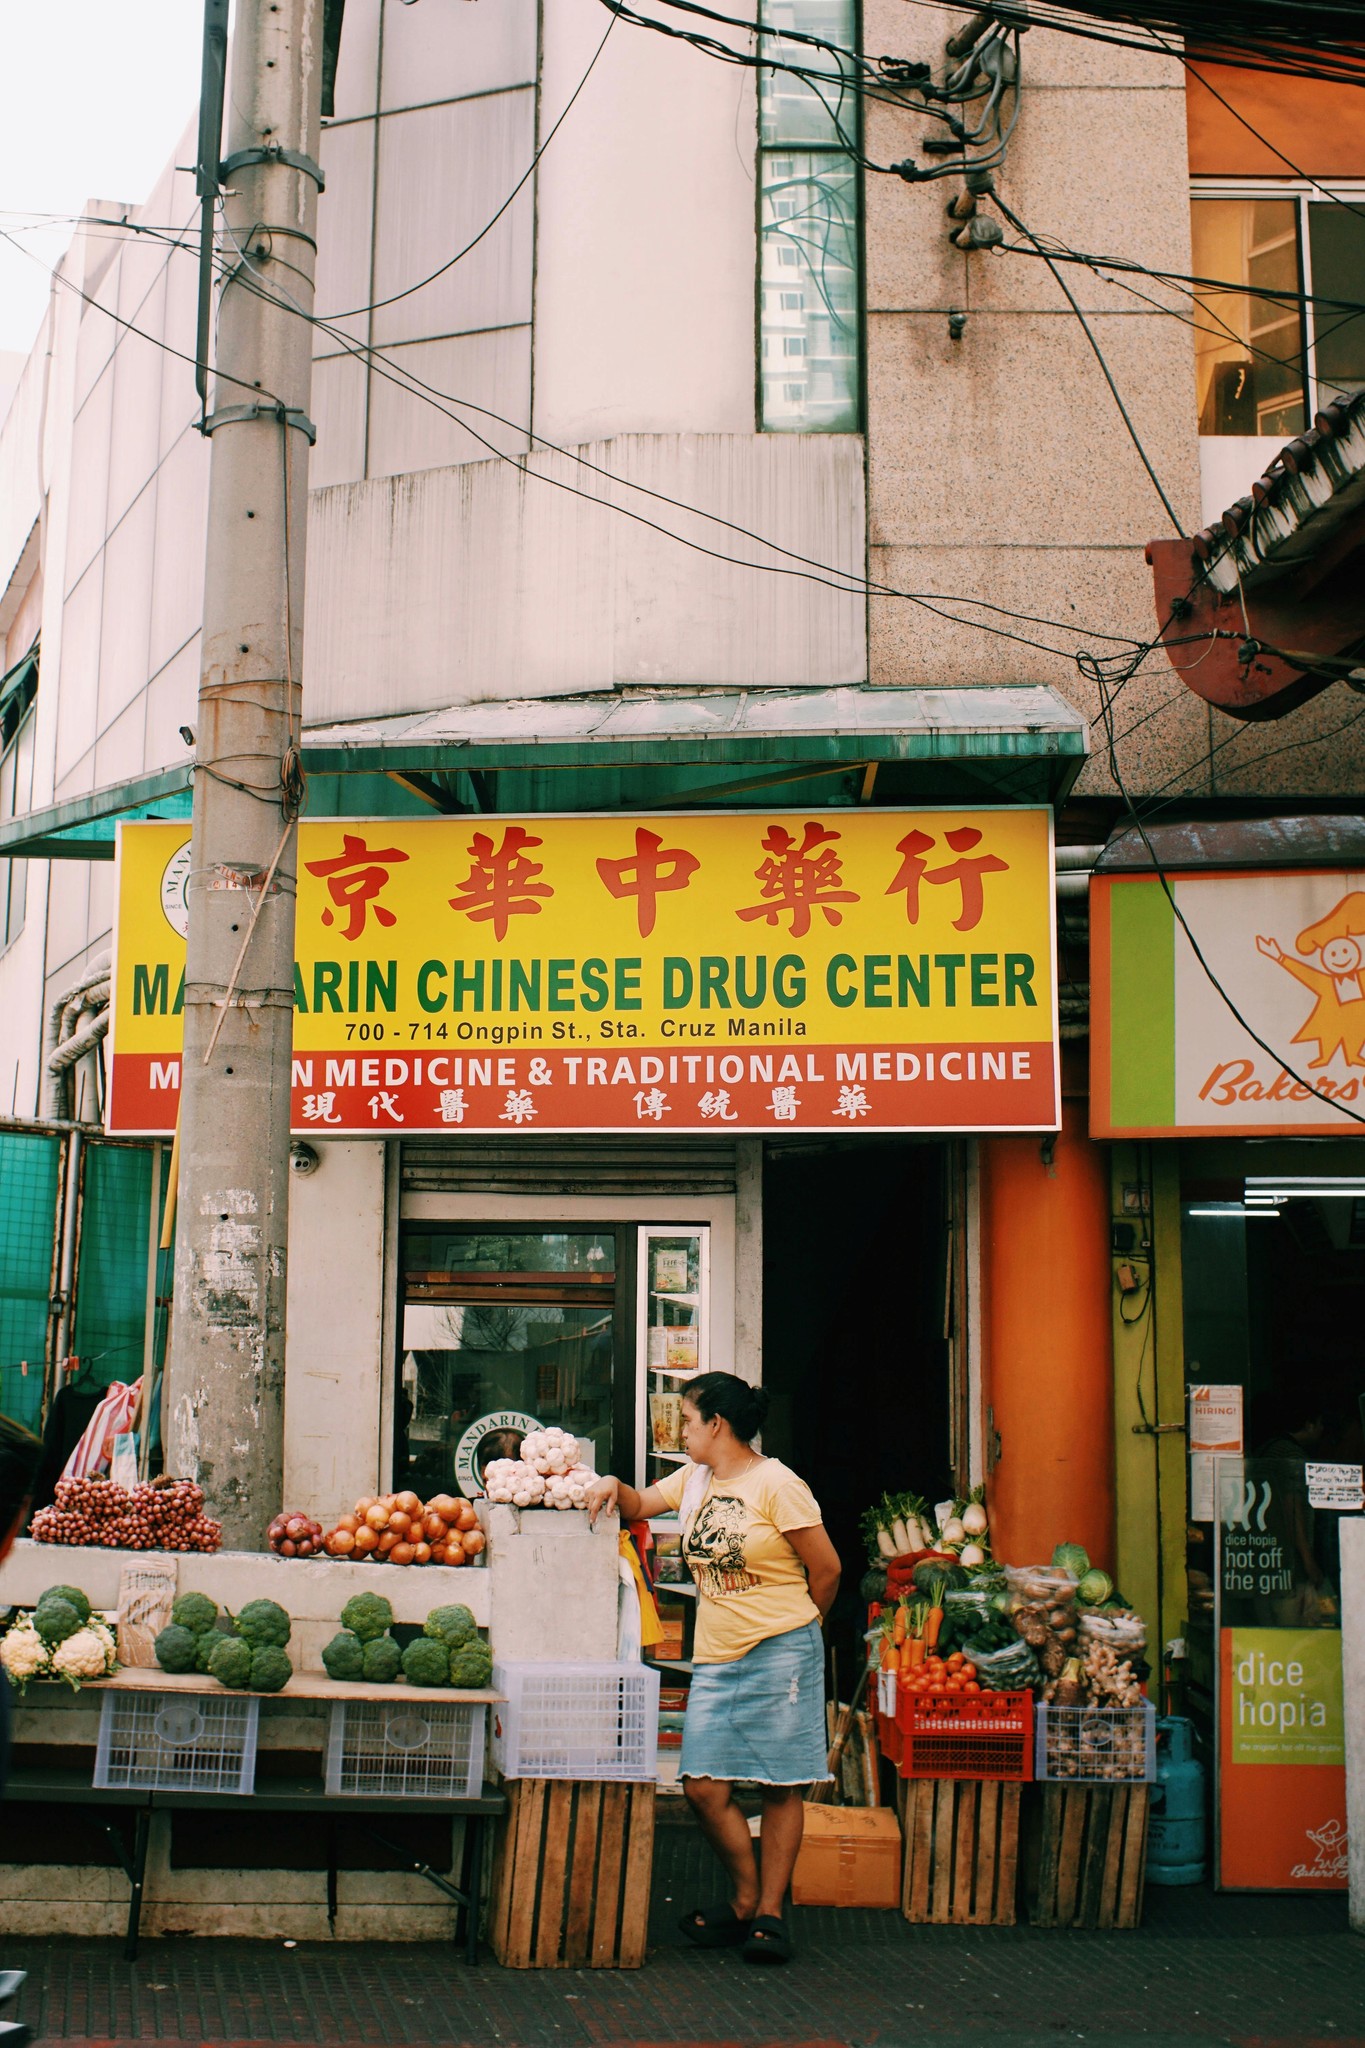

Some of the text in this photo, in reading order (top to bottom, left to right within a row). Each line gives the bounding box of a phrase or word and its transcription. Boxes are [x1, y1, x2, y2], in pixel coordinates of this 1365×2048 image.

[304, 821, 1010, 943] 京華中藥行
[417, 958, 642, 1014] CHINESE
[663, 954, 807, 1010] DRUG
[826, 952, 1038, 1009] CENTER
[345, 1024, 384, 1041] 700
[408, 1023, 448, 1040] 714
[456, 1022, 543, 1045] Ongpin
[552, 1022, 590, 1042] St.,
[600, 1020, 646, 1038] Sta.
[660, 1019, 716, 1037] Cruz
[728, 1018, 807, 1036] Manila
[325, 1057, 516, 1087] MEDICINE
[528, 1057, 553, 1086] &
[563, 1055, 825, 1085] TRADITIONAL
[835, 1051, 1031, 1082] MEDICINE
[1198, 1059, 1365, 1106] Bakers
[302, 1084, 873, 1124] 現代醫藥 傳統醫藥
[1195, 1407, 1236, 1415] HIRING!
[458, 1415, 530, 1469] MANDARIN
[1225, 1534, 1277, 1548] dice hopia
[1225, 1548, 1283, 1568] hot off
[1224, 1569, 1291, 1595] the grill
[1238, 1652, 1304, 1686] dice
[1239, 1692, 1326, 1733] hopia
